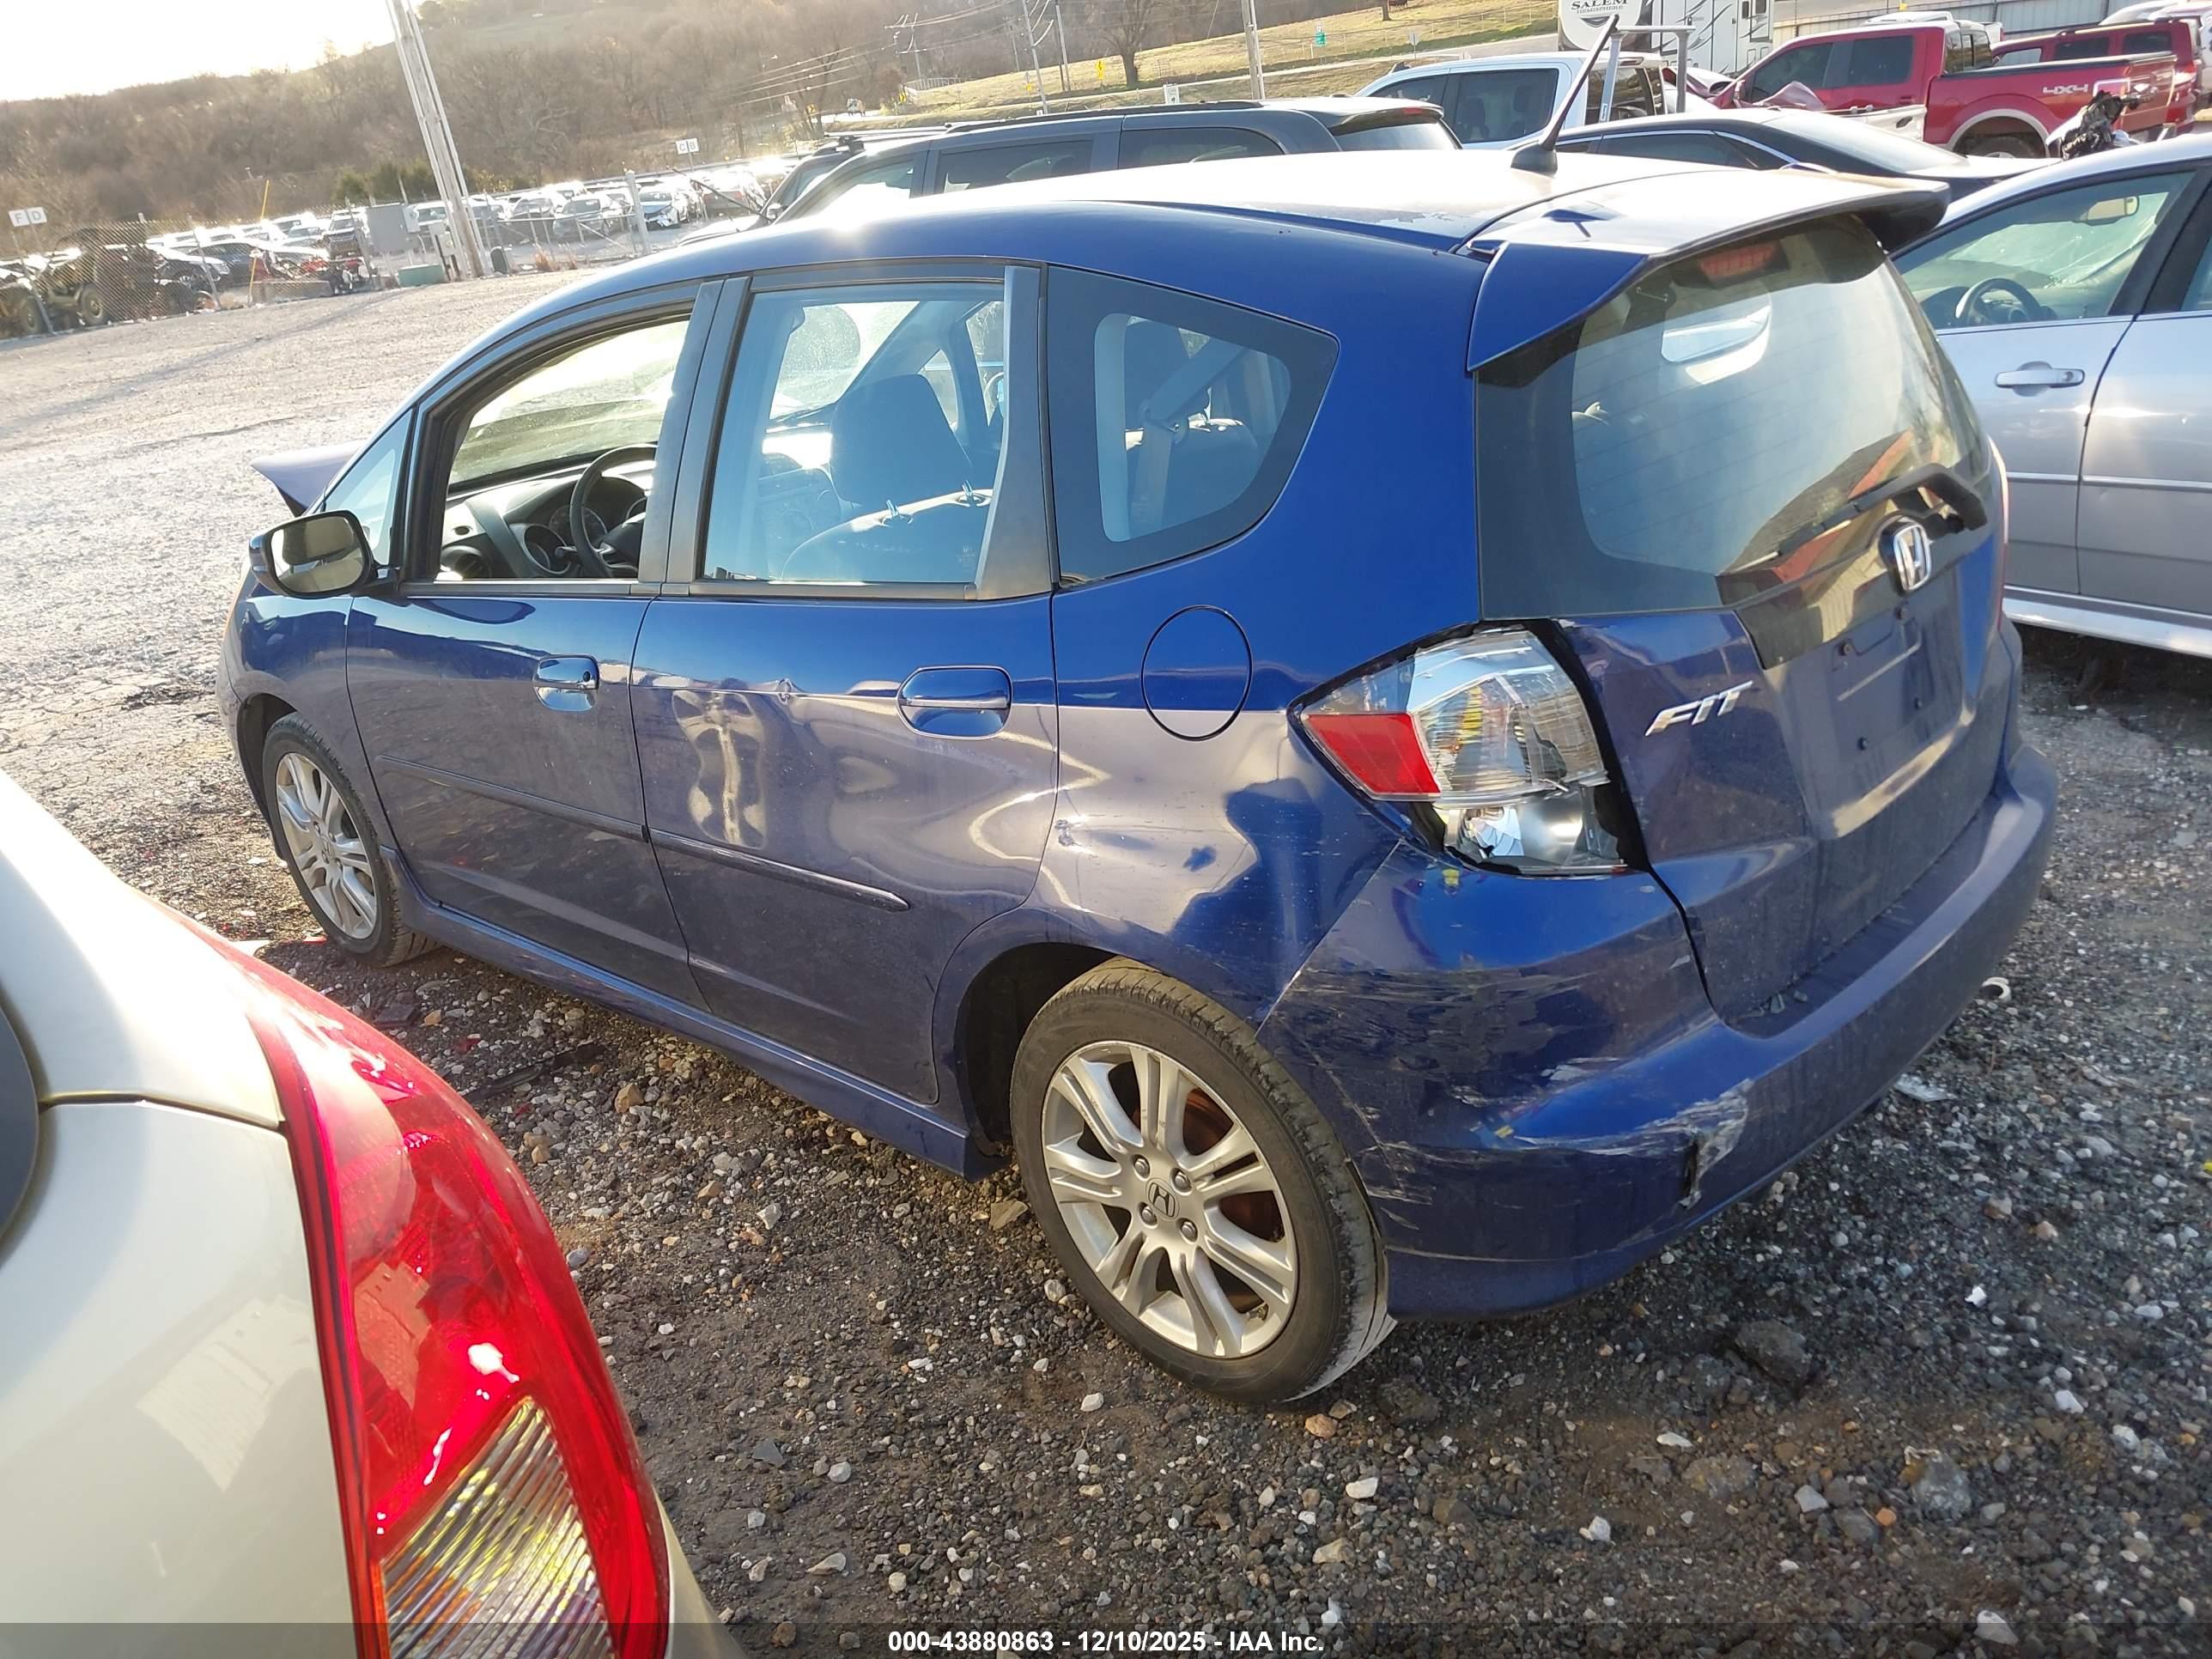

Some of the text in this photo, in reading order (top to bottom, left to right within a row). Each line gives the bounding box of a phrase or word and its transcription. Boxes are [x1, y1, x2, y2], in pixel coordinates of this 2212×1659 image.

[1571, 0, 1628, 10] SALEM
[14, 210, 41, 224] F D
[1644, 680, 1754, 738] FIT
